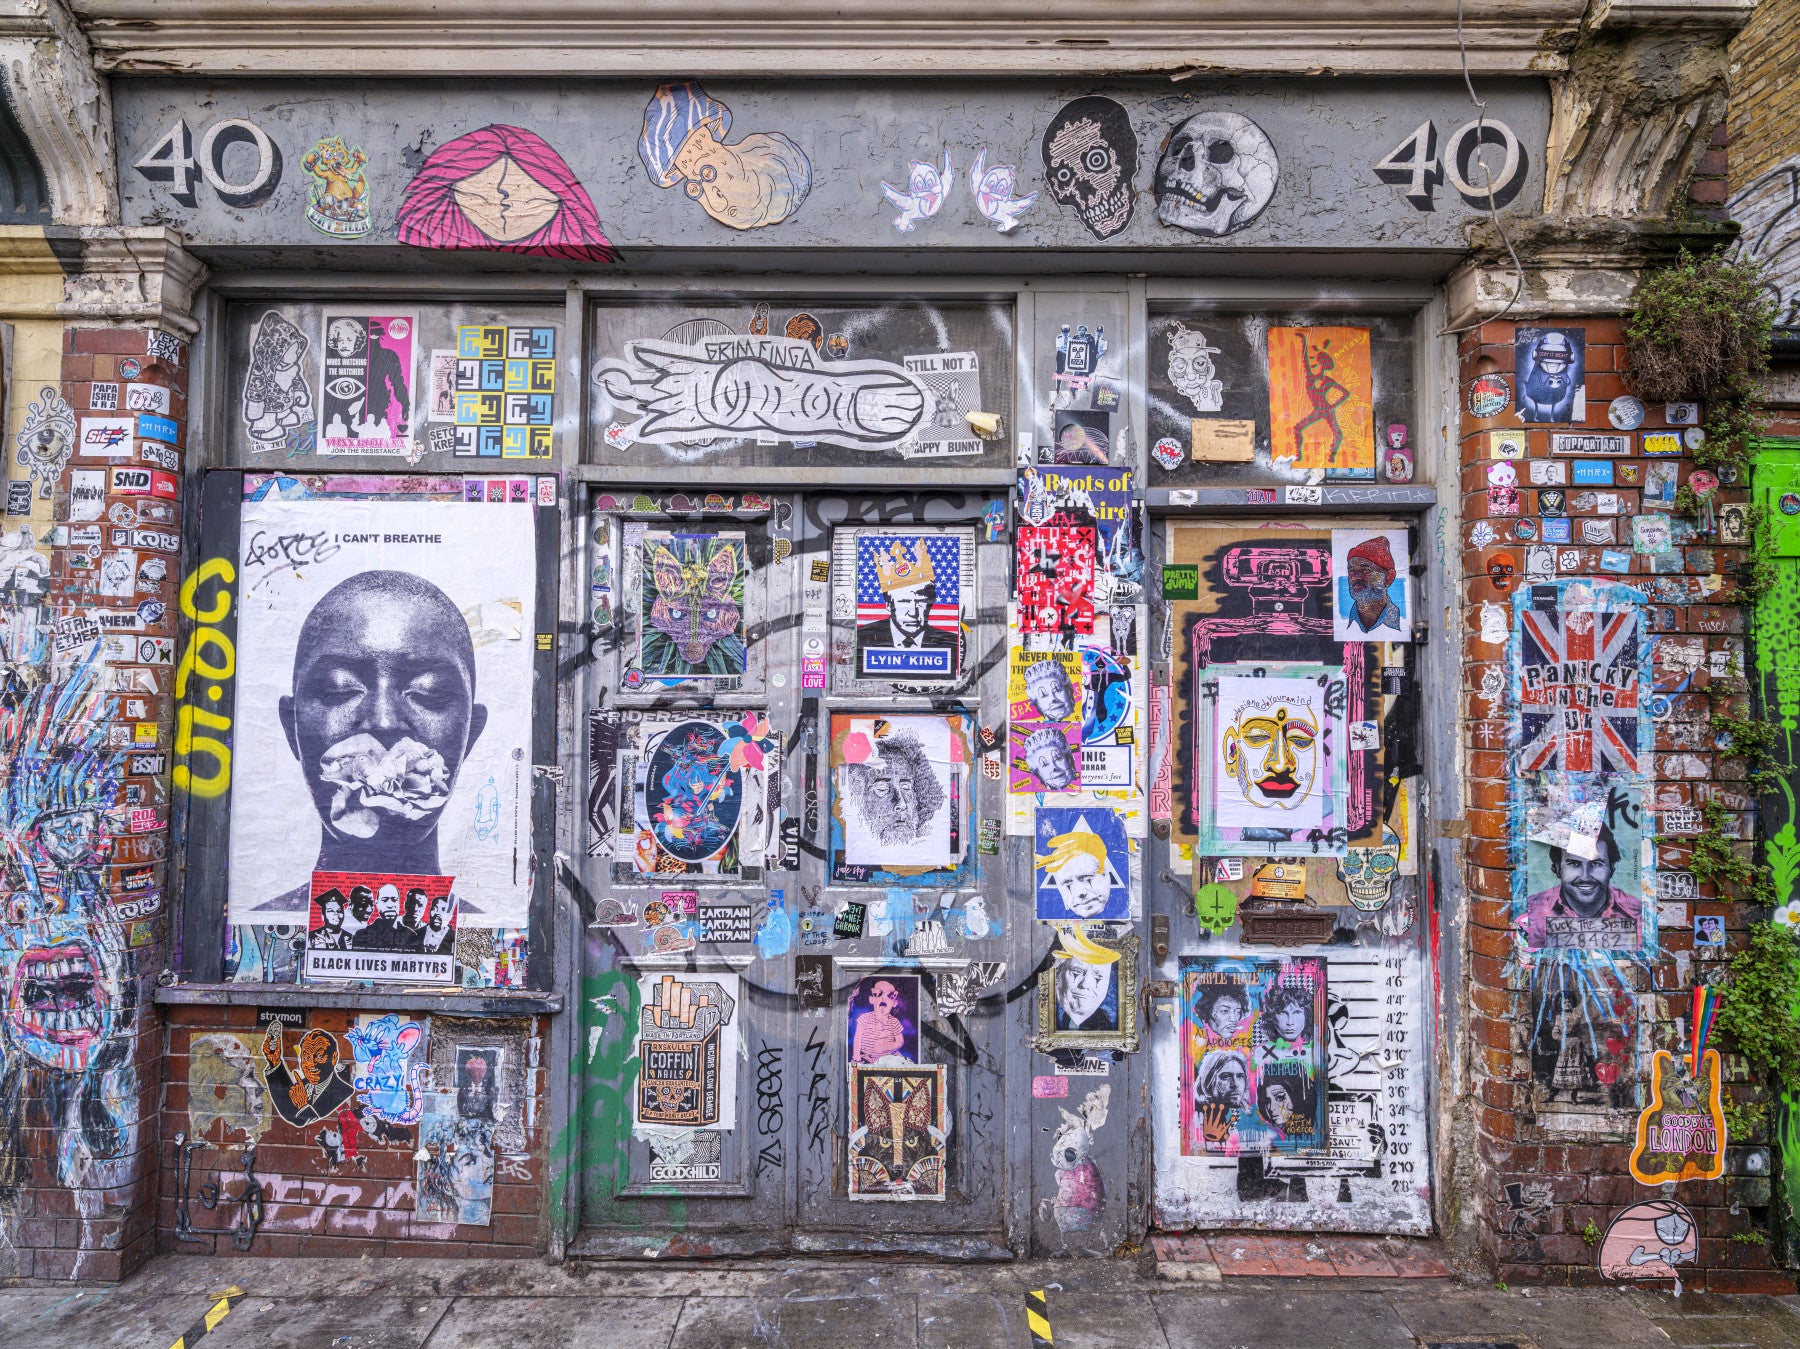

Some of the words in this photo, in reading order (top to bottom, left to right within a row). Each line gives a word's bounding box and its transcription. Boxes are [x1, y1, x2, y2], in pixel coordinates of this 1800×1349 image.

[132, 117, 284, 209] 40
[1373, 117, 1529, 212] 40
[328, 367, 338, 375] THE
[905, 359, 938, 375] STILL
[942, 358, 964, 371] NOT
[970, 357, 978, 370] A
[93, 384, 118, 394] PAPA
[92, 393, 117, 402] ISHER
[914, 442, 941, 455] APPY
[947, 440, 981, 454] BUNNY
[1558, 437, 1600, 451] SUPPORT
[1603, 437, 1621, 451] ART
[114, 472, 150, 487] SND
[1108, 471, 1133, 492] of
[133, 530, 180, 552] KORS
[334, 534, 338, 543] I
[342, 534, 381, 543] CAN'T
[383, 533, 442, 543] BREATHE
[1162, 569, 1198, 583] PRETTY
[871, 654, 906, 666] LYIN'
[908, 656, 943, 666] KING
[1019, 652, 1048, 663] NEVER
[1051, 652, 1074, 663] MIND
[803, 678, 824, 688] LOVE
[1290, 695, 1313, 706] mind
[1081, 751, 1106, 762] INIC
[1255, 922, 1318, 934] LETTERS
[1546, 917, 1576, 934] FUCK
[1578, 918, 1597, 934] THE
[1601, 918, 1637, 933] SYSTEM
[312, 957, 352, 970] BLACK
[355, 959, 387, 972] LIVES
[390, 961, 448, 974] MARTYRS
[1385, 1013, 1409, 1025] 4'2"
[1384, 1030, 1409, 1043] 4'0"
[650, 1052, 693, 1070] COFFIN
[657, 1069, 684, 1079] NAILS
[1263, 1062, 1300, 1077] REHAB
[354, 1075, 405, 1091] CRAZY!
[1388, 1086, 1410, 1099] 3'6"
[1388, 1105, 1411, 1117] 3'4"
[1661, 1113, 1714, 1129] GOODBYE
[1389, 1124, 1411, 1136] 3'2"
[1649, 1127, 1719, 1156] LONDON
[1389, 1142, 1412, 1155] 3'0"
[652, 1165, 719, 1179] GOODCHILD
